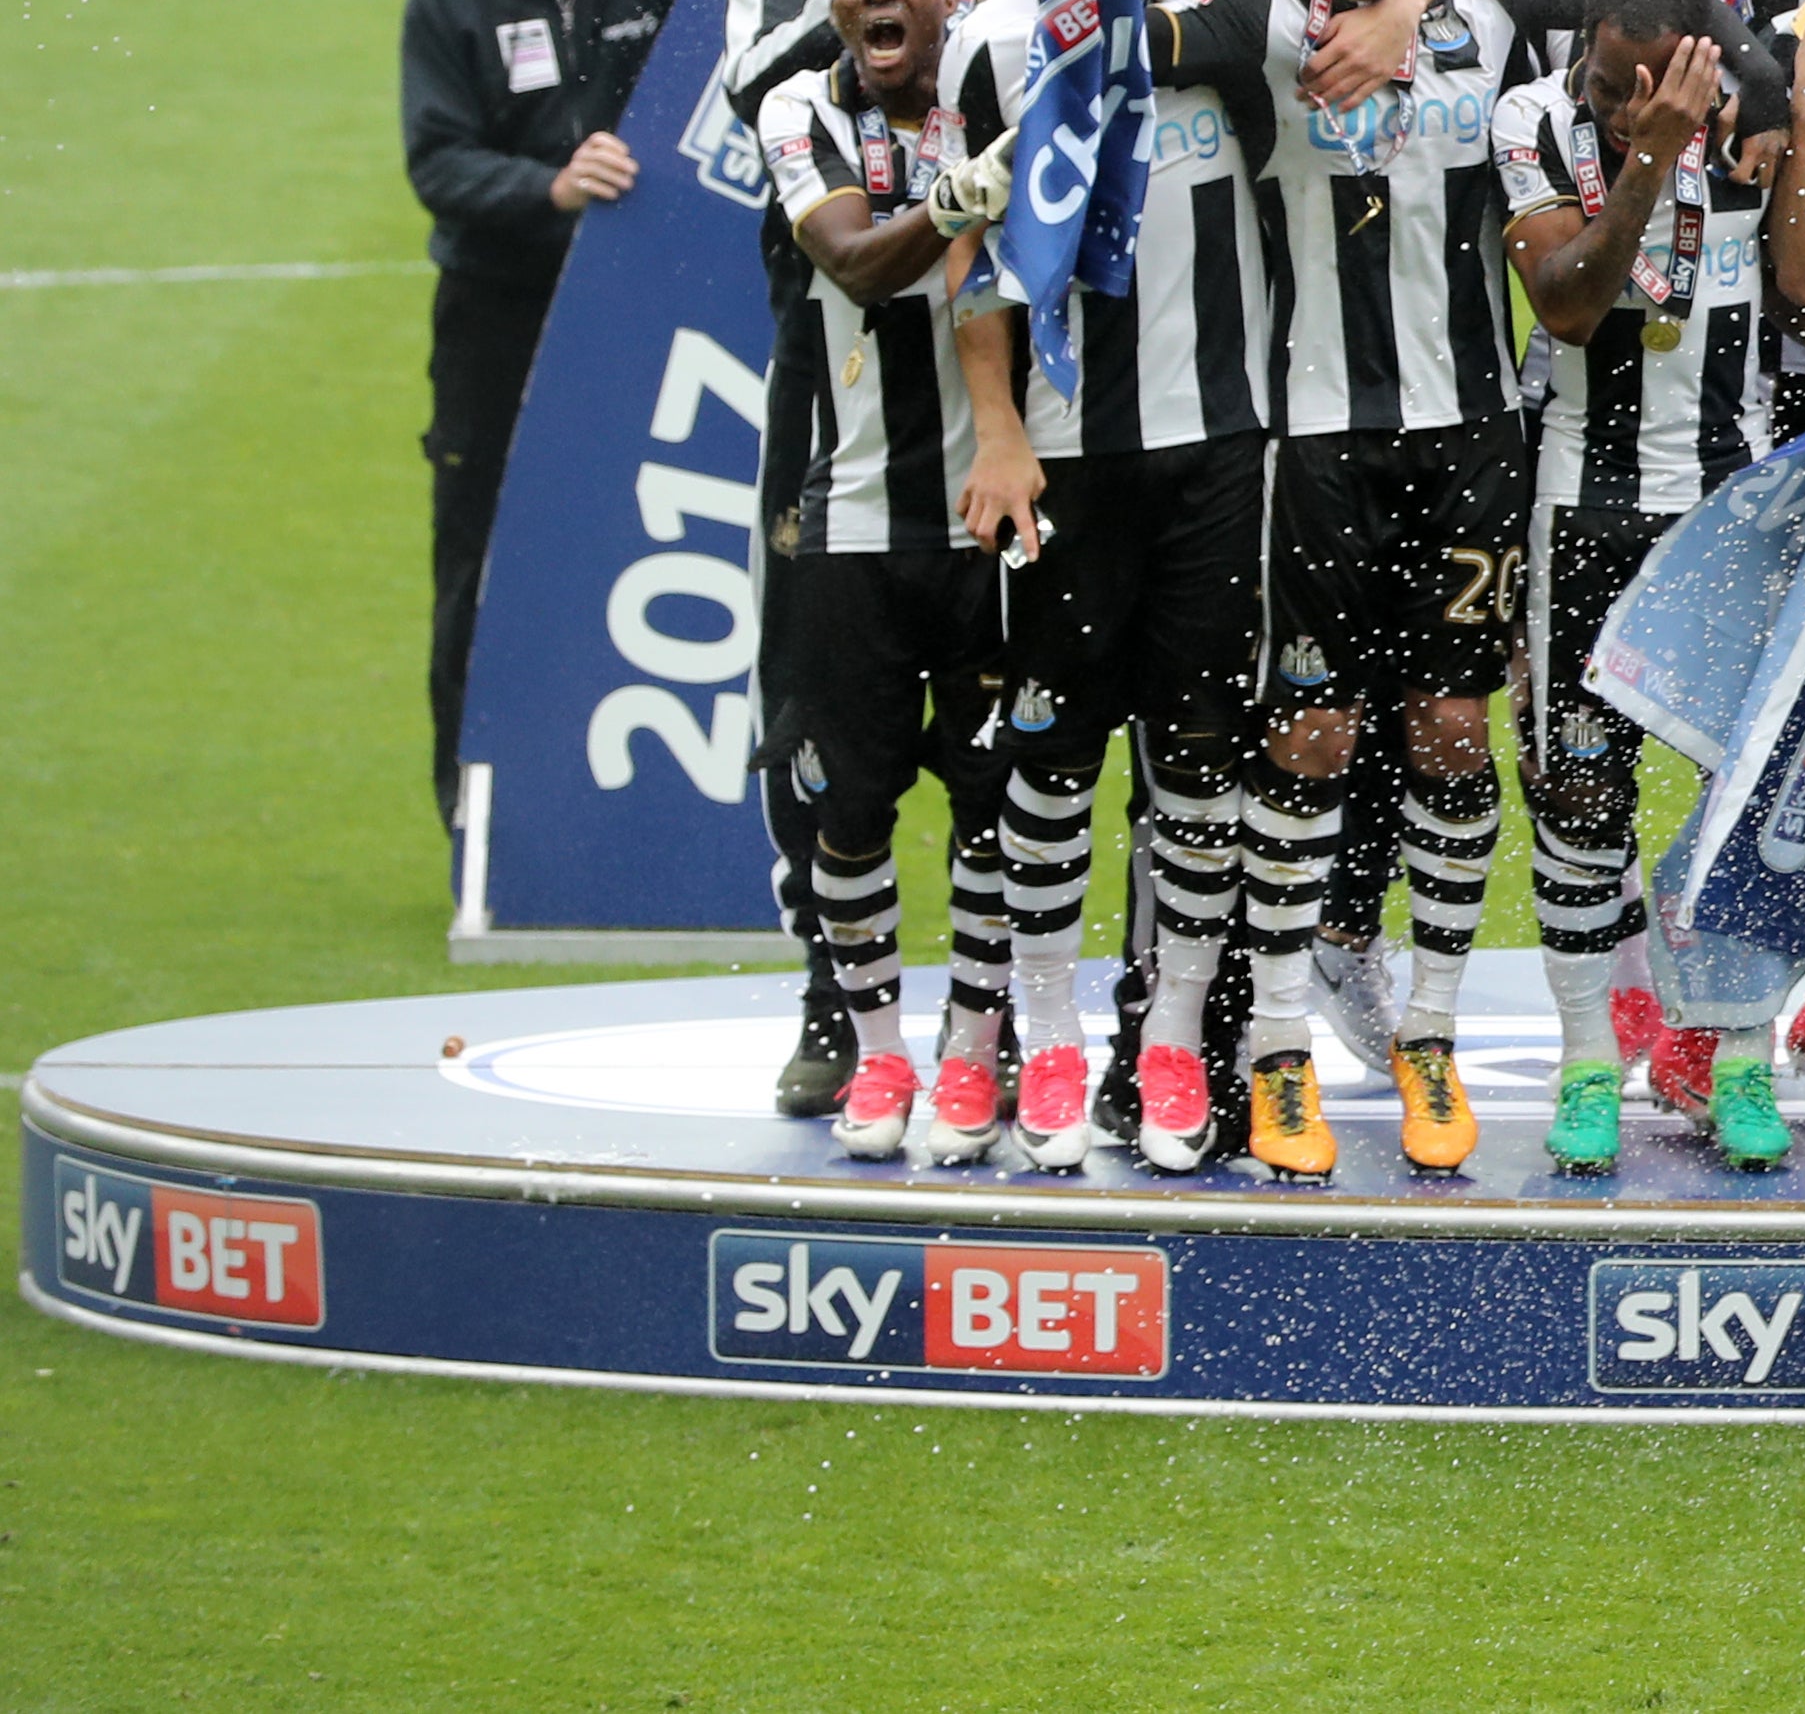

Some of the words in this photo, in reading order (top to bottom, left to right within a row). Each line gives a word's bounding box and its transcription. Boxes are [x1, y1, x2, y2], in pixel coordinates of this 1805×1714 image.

[866, 142, 890, 191] BET
[1578, 164, 1605, 215] BET
[1679, 213, 1700, 253] BET
[1630, 255, 1670, 302] BET
[1672, 255, 1698, 298] sky
[587, 326, 768, 804] 2017
[1446, 549, 1521, 624] 20
[63, 1176, 141, 1293] sky
[168, 1209, 298, 1304] BET
[732, 1244, 901, 1358] sky
[949, 1267, 1140, 1354] BET
[1616, 1269, 1800, 1383] sky
